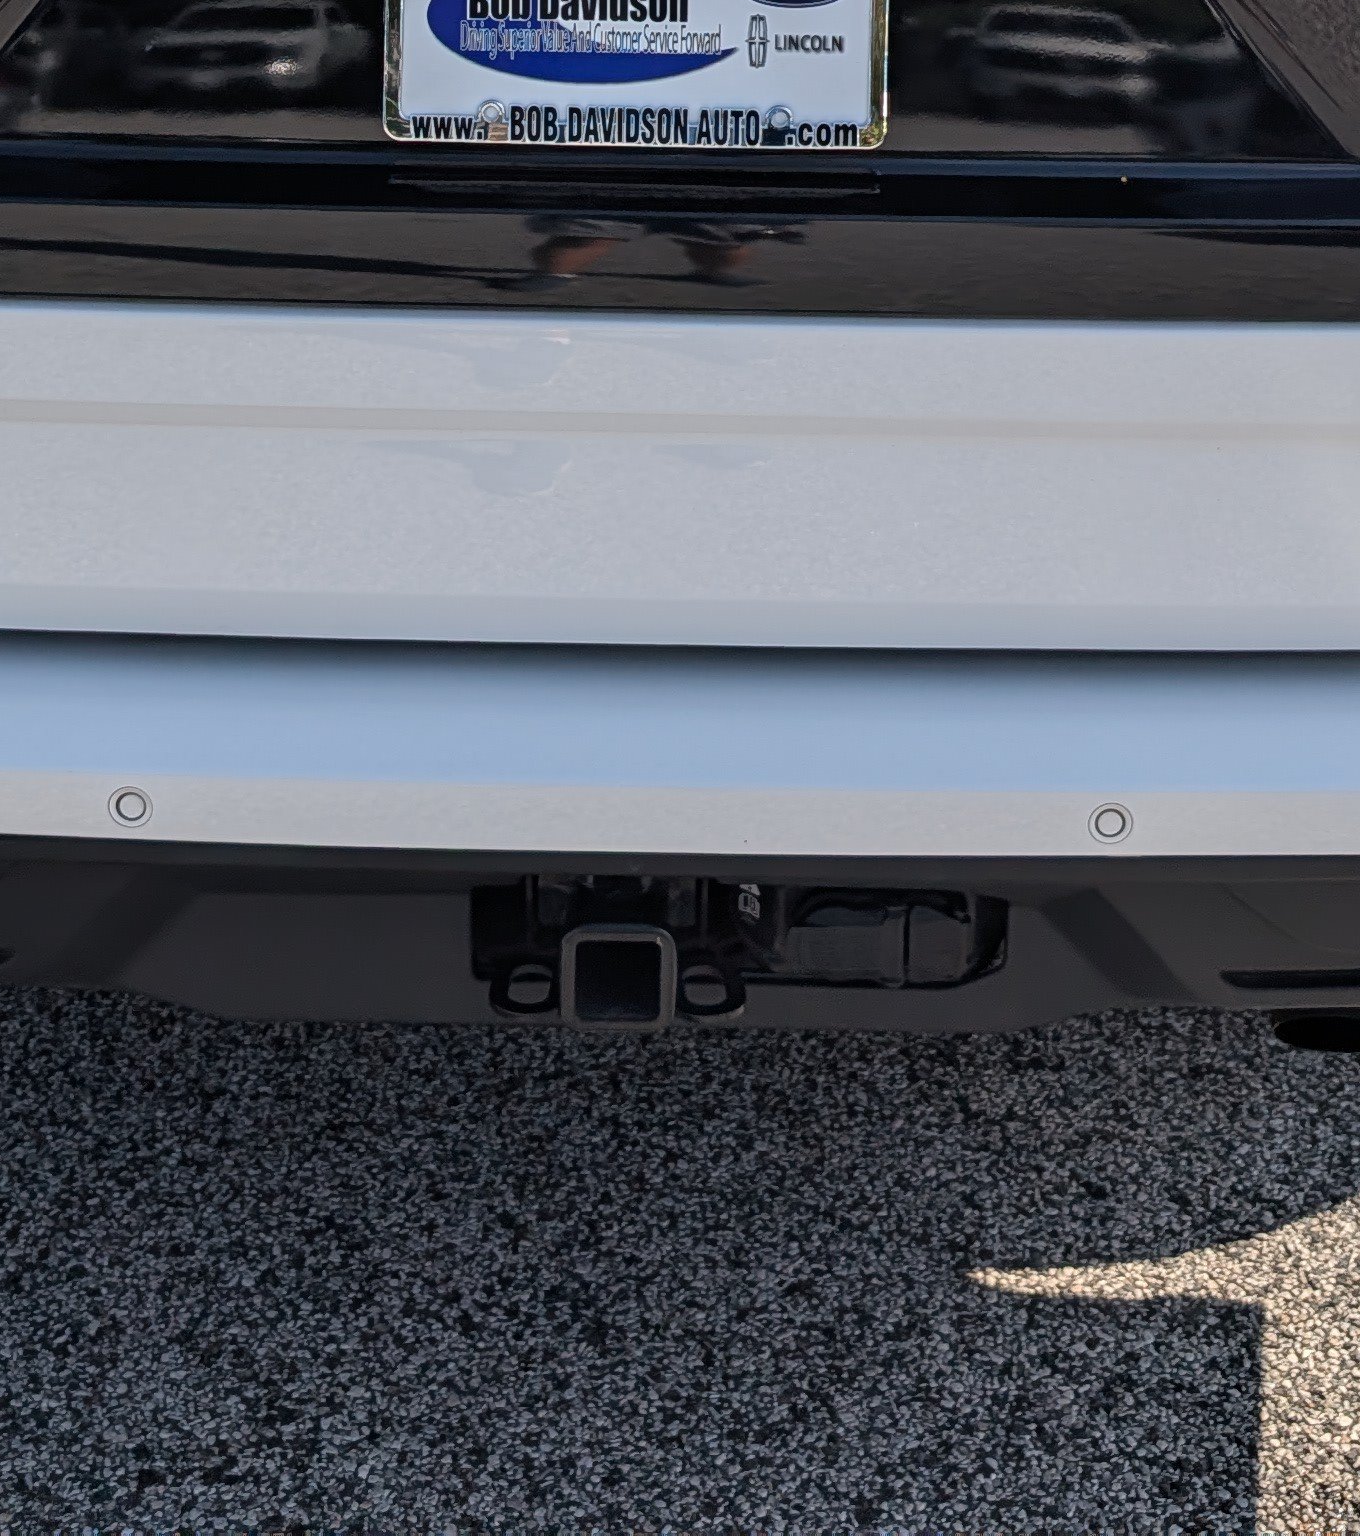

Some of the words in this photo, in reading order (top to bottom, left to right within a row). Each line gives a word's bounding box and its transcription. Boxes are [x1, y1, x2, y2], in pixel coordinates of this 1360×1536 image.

[460, 20, 497, 60] Driving
[498, 20, 540, 60] Superior
[540, 20, 570, 53] Value
[570, 21, 592, 53] And
[593, 22, 642, 53] Customer
[643, 23, 679, 54] Service
[680, 24, 721, 54] Forward
[774, 34, 844, 53] LINCOLN
[412, 115, 488, 140] www.
[510, 105, 558, 142] BOB
[568, 107, 688, 145] DAVIDSON
[697, 109, 761, 146] AUTO
[785, 122, 859, 147] .com
